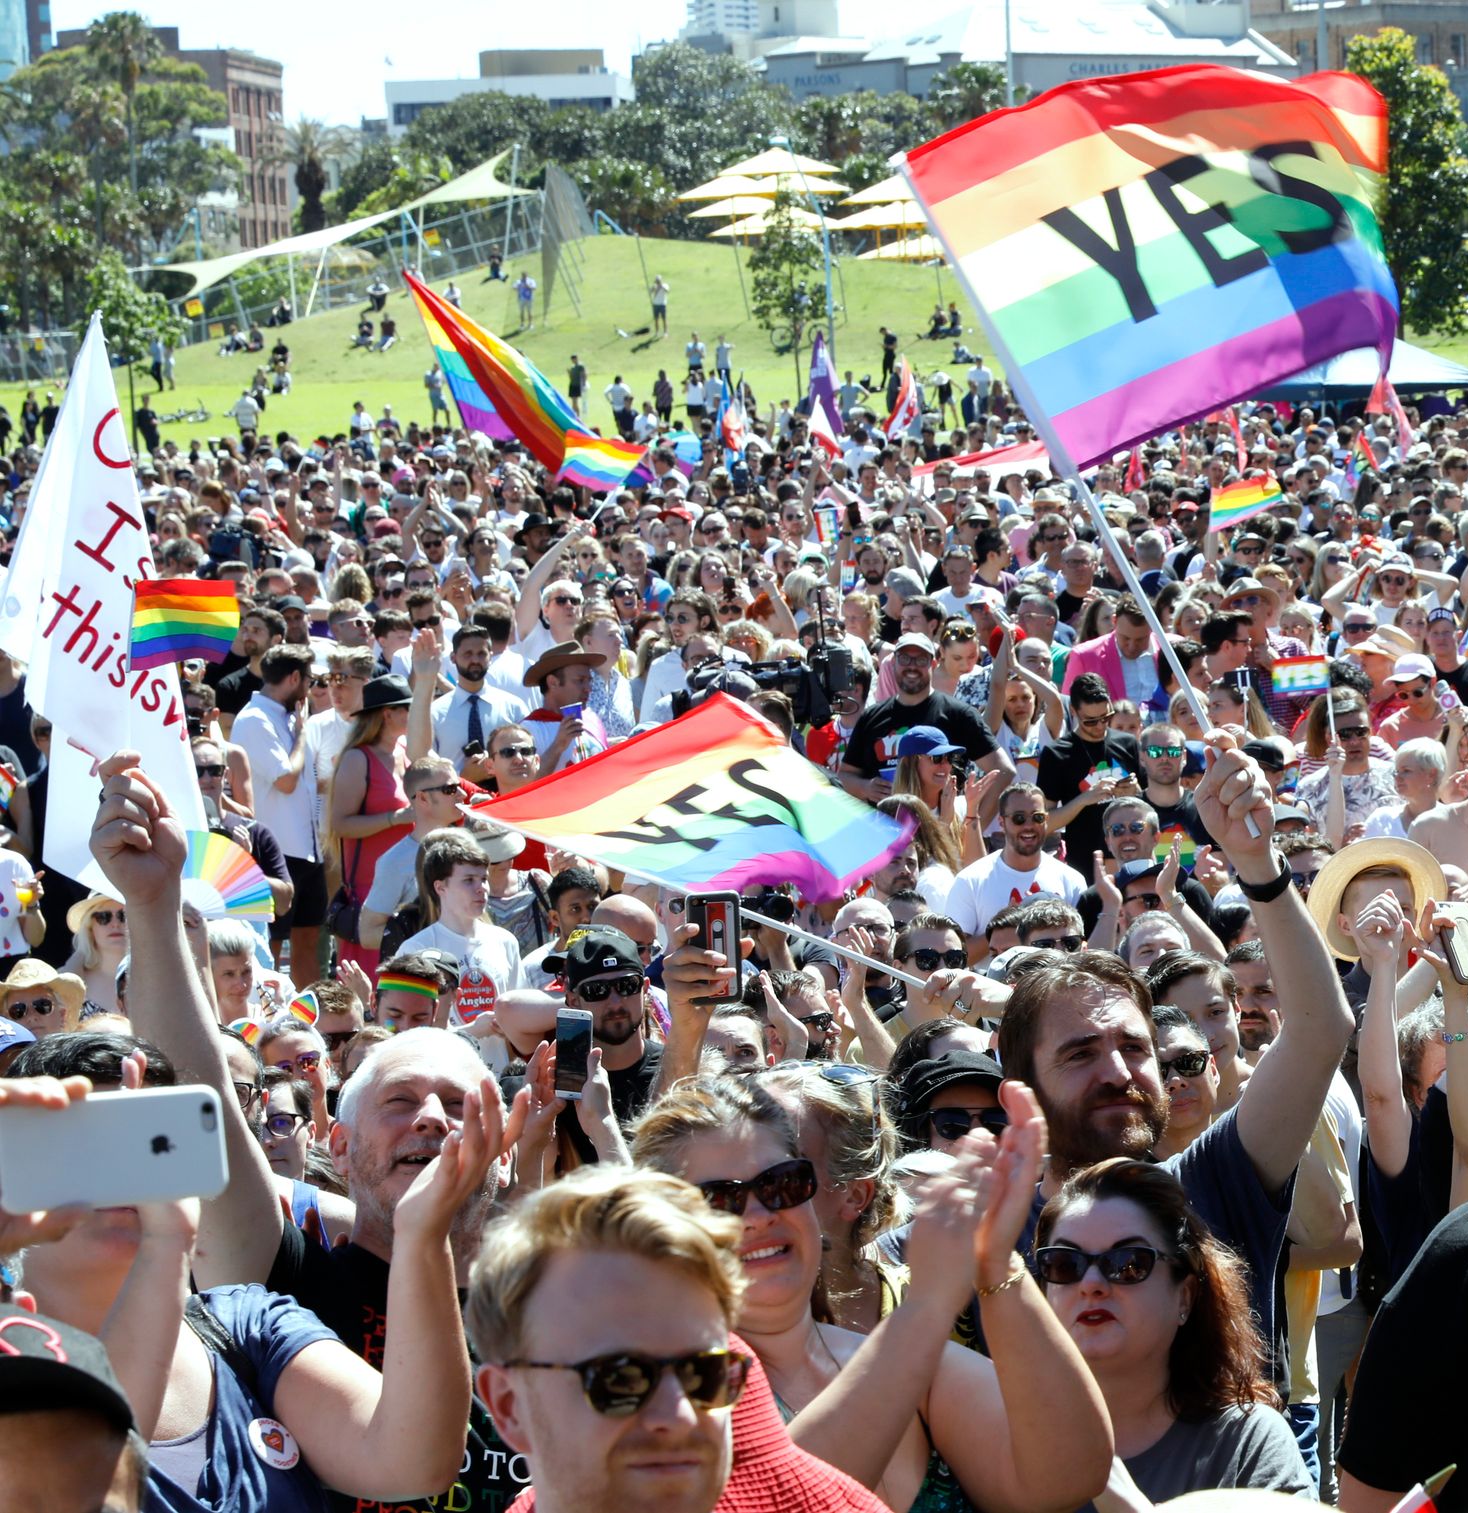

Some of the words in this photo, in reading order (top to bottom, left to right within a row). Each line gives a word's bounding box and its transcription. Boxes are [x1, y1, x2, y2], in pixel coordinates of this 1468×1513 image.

[1070, 63, 1129, 75] CHARLES
[795, 73, 841, 87] PARSONS
[1041, 140, 1352, 324] YES
[1274, 662, 1327, 688] YES
[594, 757, 802, 852] YES
[459, 996, 494, 1008] Angkor
